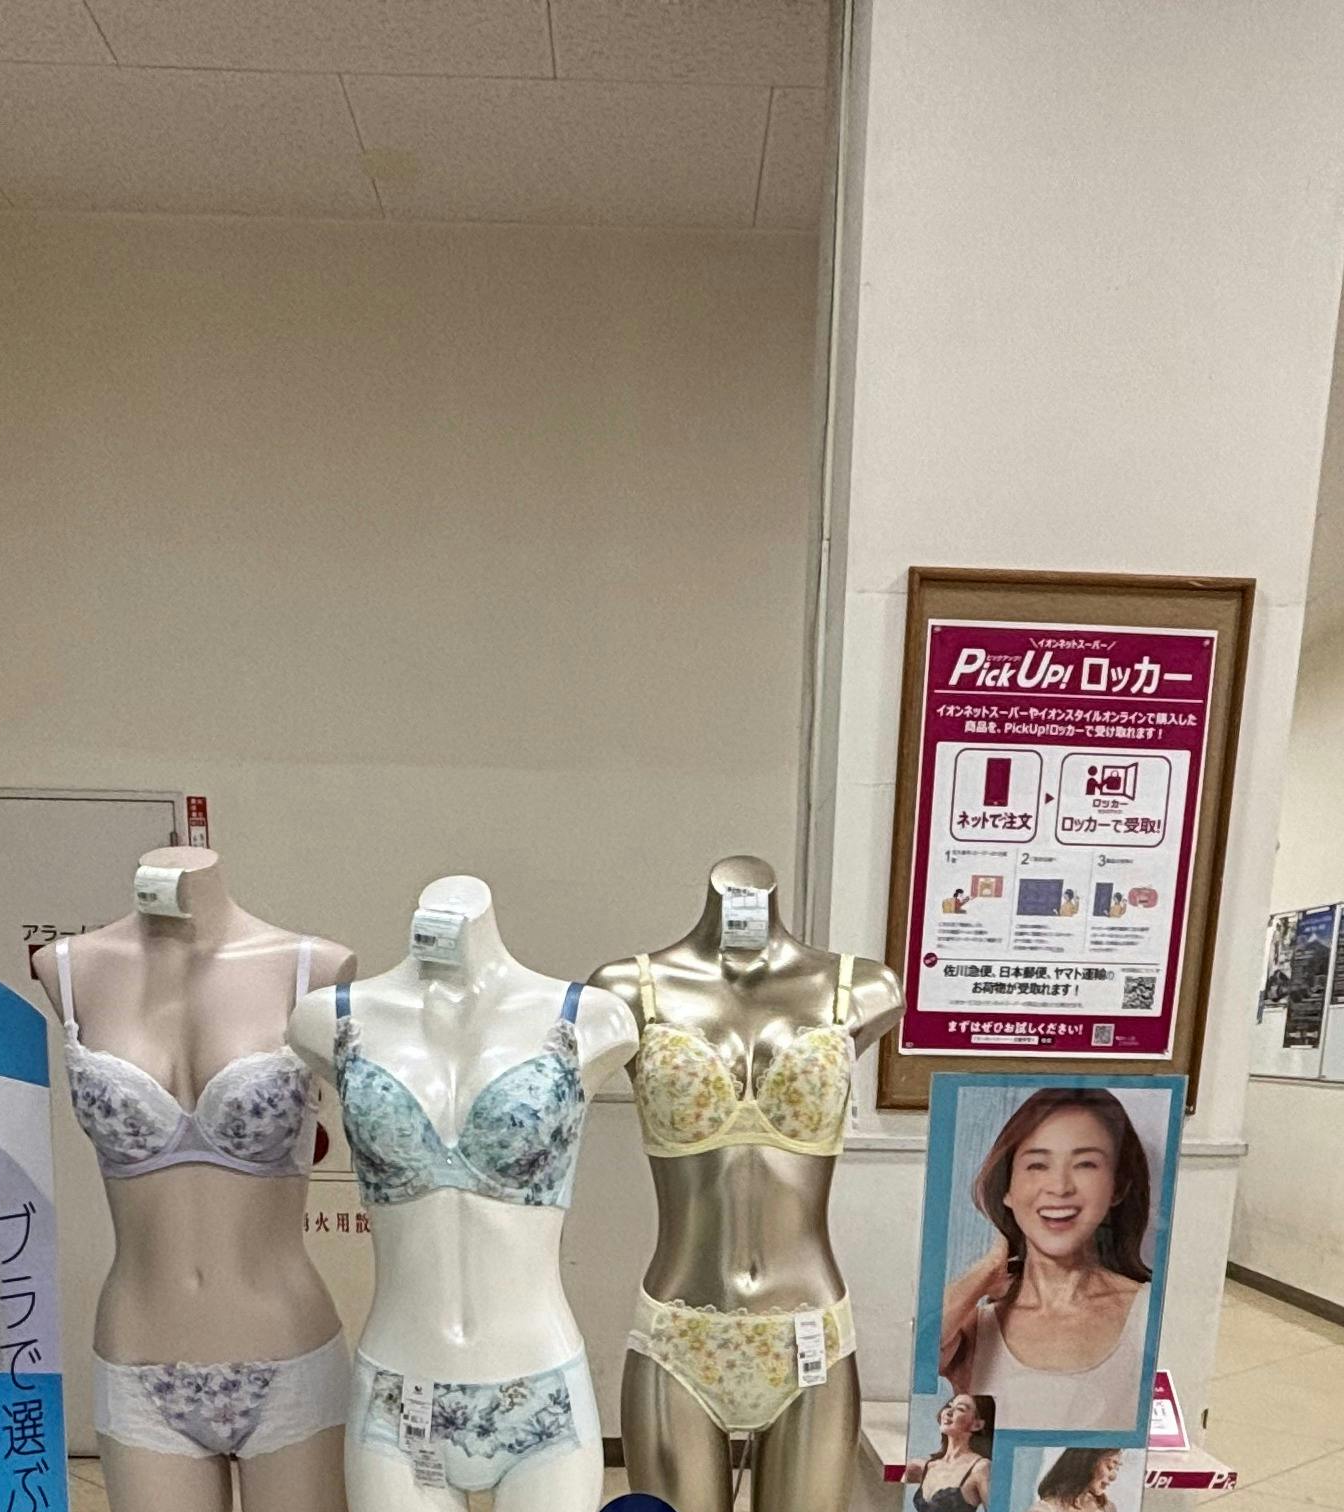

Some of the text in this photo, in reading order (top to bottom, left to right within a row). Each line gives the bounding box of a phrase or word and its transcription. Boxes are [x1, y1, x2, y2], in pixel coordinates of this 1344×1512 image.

[1080, 655, 1193, 695] ロッカー
[1092, 798, 1129, 809] ロッカー
[957, 811, 1033, 831] ネットで注文
[1060, 815, 1162, 835] ロッカーで受取!
